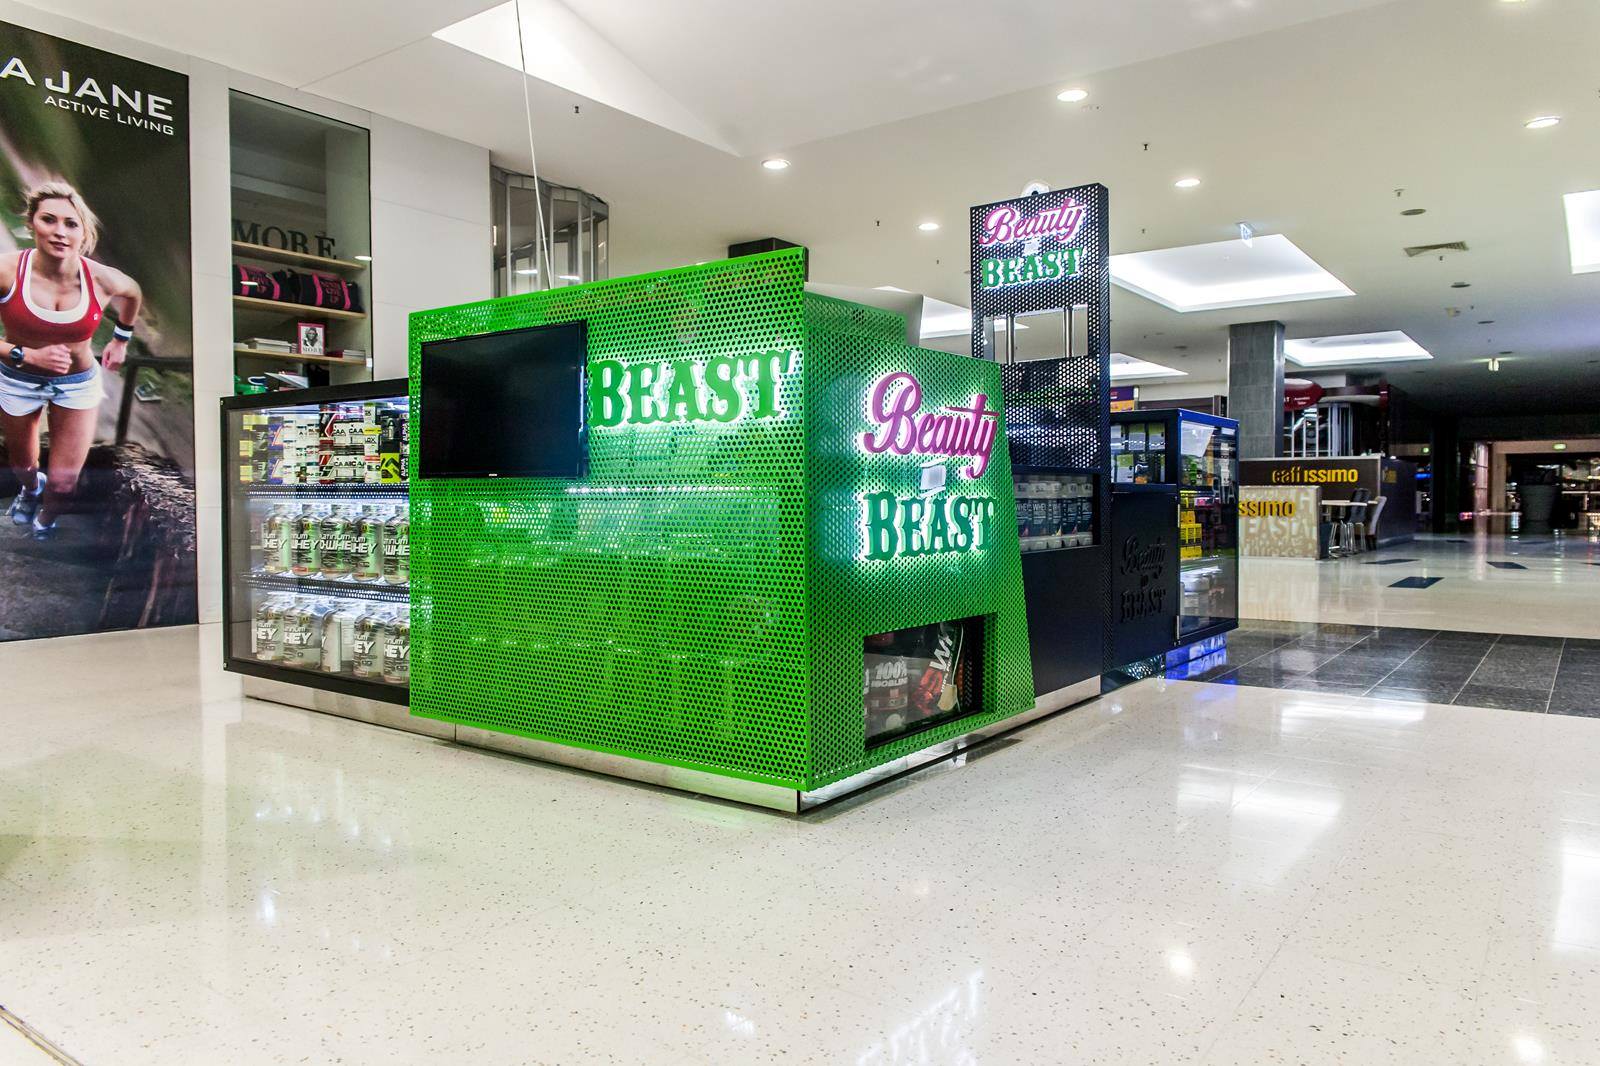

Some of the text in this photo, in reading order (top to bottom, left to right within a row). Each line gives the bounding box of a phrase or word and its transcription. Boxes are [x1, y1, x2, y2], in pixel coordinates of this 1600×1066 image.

[44, 70, 173, 121] JANE
[44, 95, 174, 136] ACTIVE LIVING
[978, 197, 1087, 245] Beauty
[980, 246, 1084, 289] BEAST
[588, 350, 796, 428] BEAST
[863, 371, 1000, 480] Beauty
[862, 490, 1000, 561] BEAST
